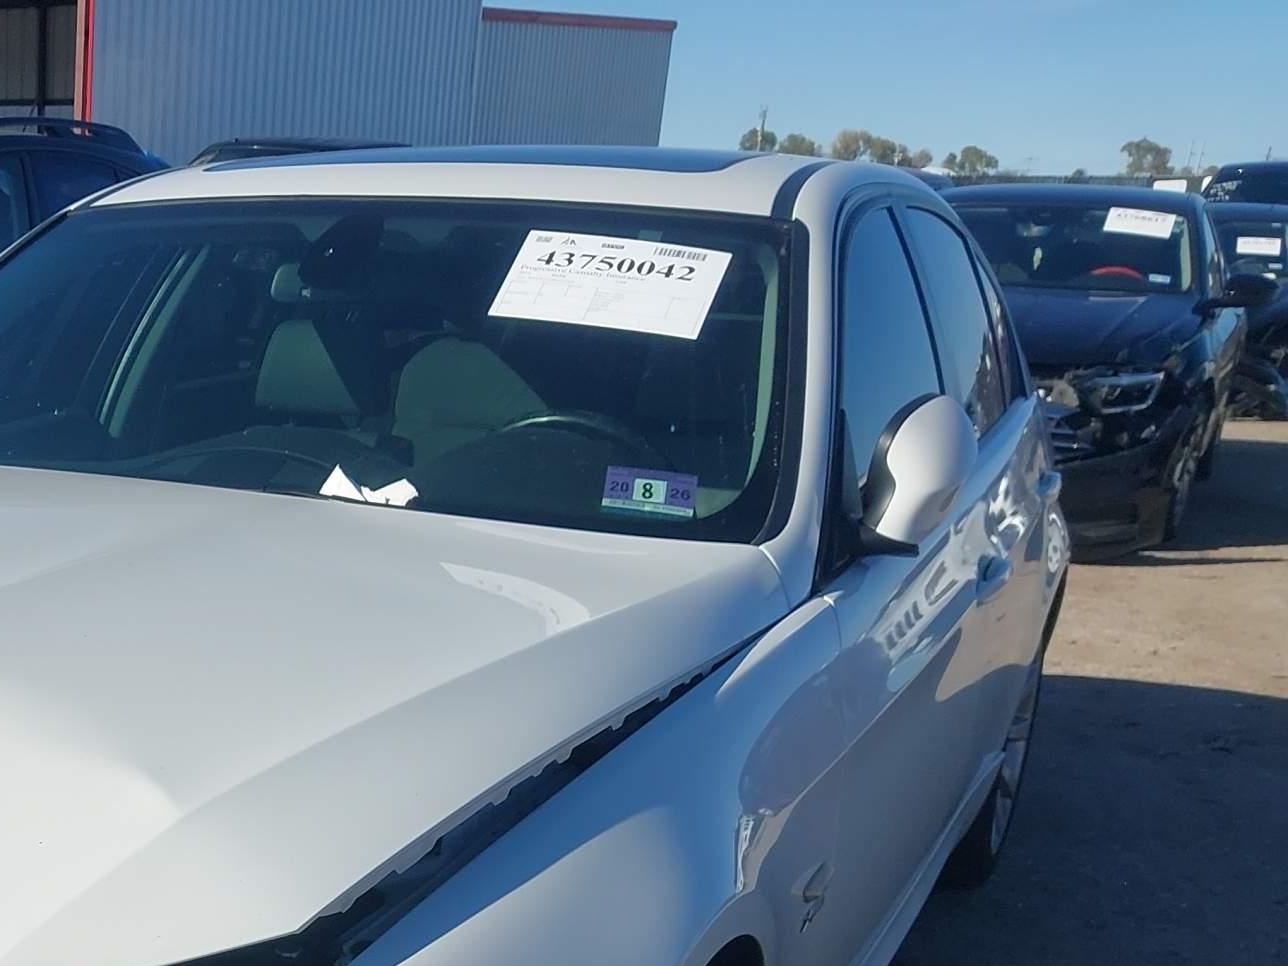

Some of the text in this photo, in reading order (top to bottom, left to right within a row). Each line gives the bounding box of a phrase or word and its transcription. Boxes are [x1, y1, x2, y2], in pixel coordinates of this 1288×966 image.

[536, 249, 697, 282] 43750042
[610, 481, 691, 501] 20 8 26
